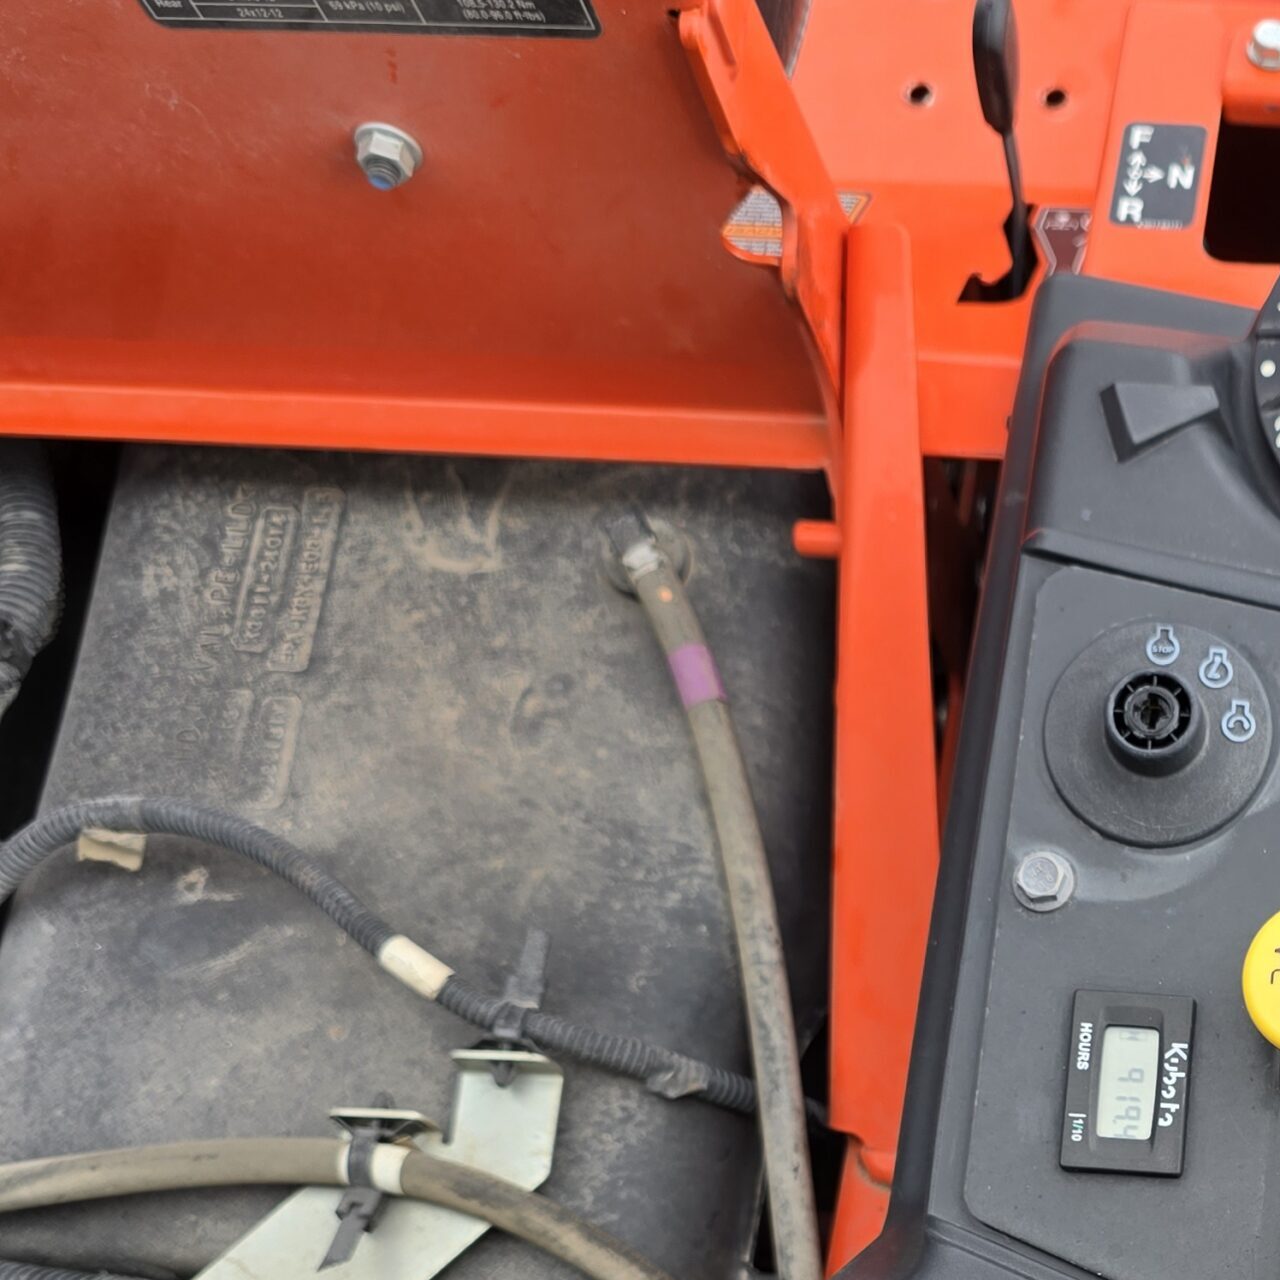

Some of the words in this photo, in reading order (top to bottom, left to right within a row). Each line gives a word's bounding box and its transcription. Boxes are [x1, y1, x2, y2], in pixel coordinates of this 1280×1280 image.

[1129, 125, 1154, 149] F
[1167, 162, 1195, 190] N
[1117, 197, 1144, 223] R
[1152, 644, 1175, 654] STOP
[1077, 1022, 1093, 1071] HOURS
[1158, 1043, 1188, 1127] Kubota
